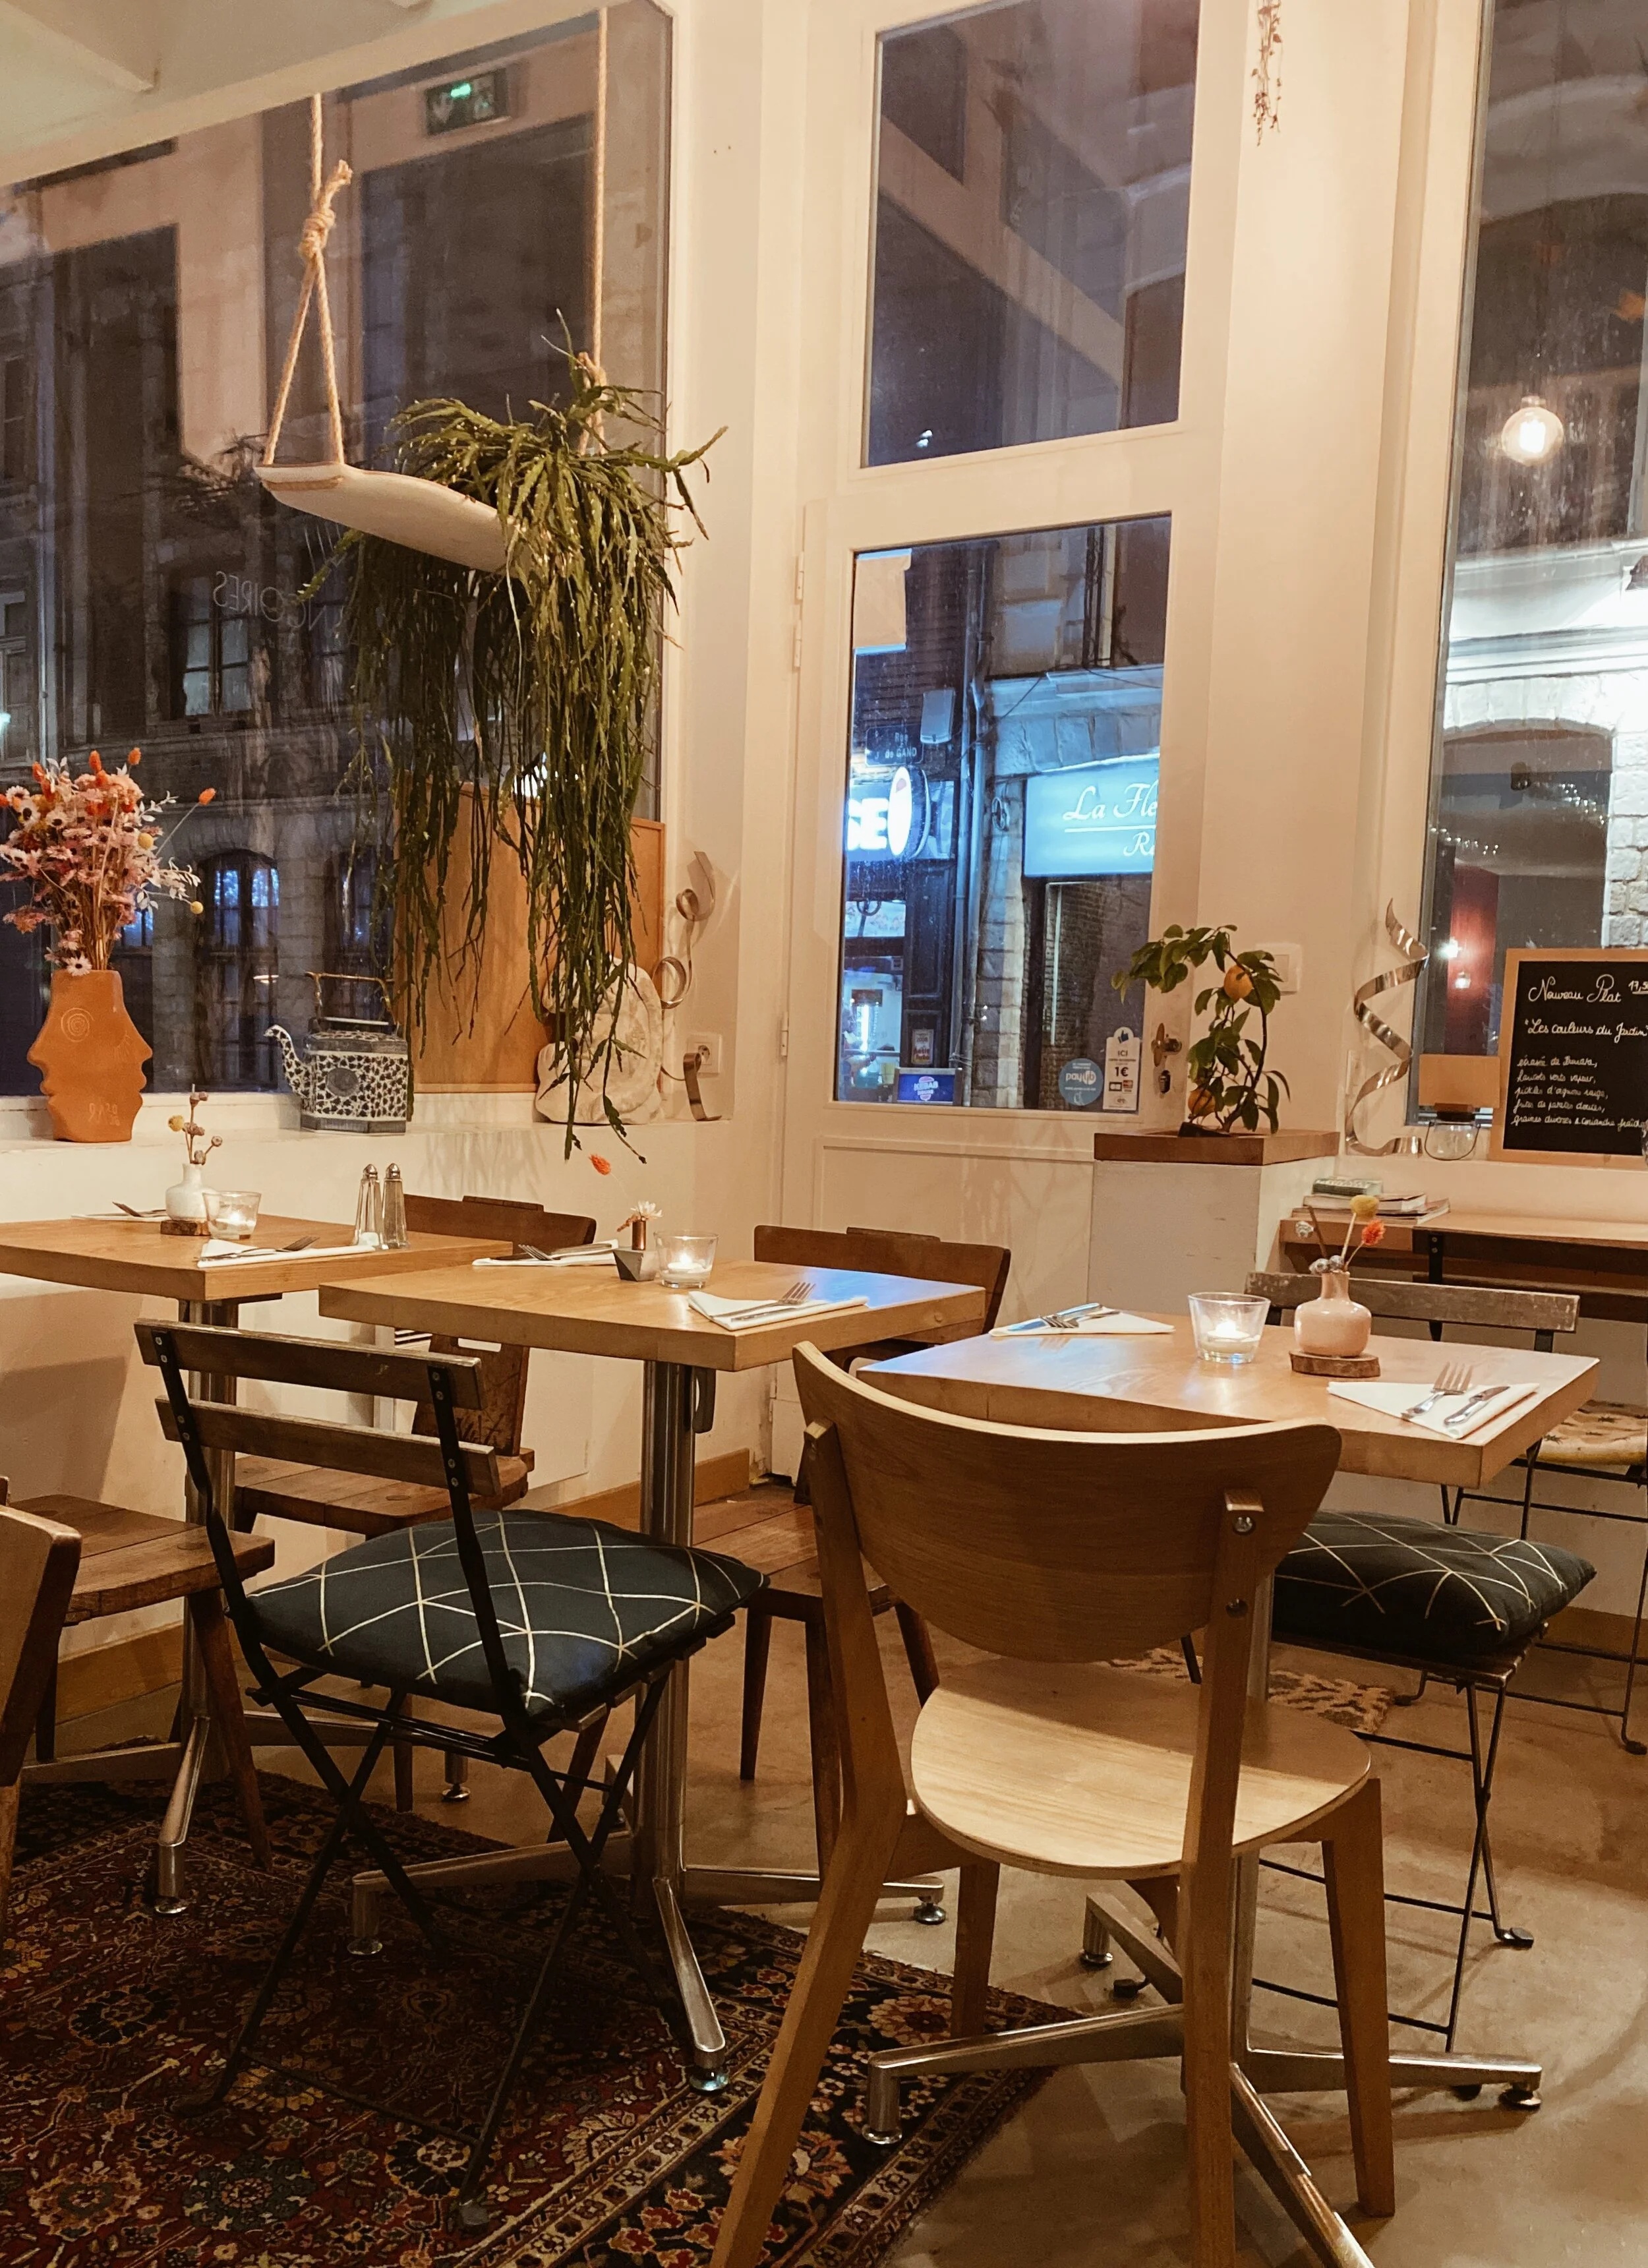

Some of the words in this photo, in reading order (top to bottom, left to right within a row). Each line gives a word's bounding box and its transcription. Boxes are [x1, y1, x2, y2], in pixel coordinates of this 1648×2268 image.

[896, 747, 917, 758] GAND
[1062, 785, 1106, 820] La
[1528, 976, 1584, 1002] Nouveau
[1587, 974, 1622, 1003] Plat
[1595, 1025, 1612, 1035] du
[1115, 1067, 1129, 1077] 1€
